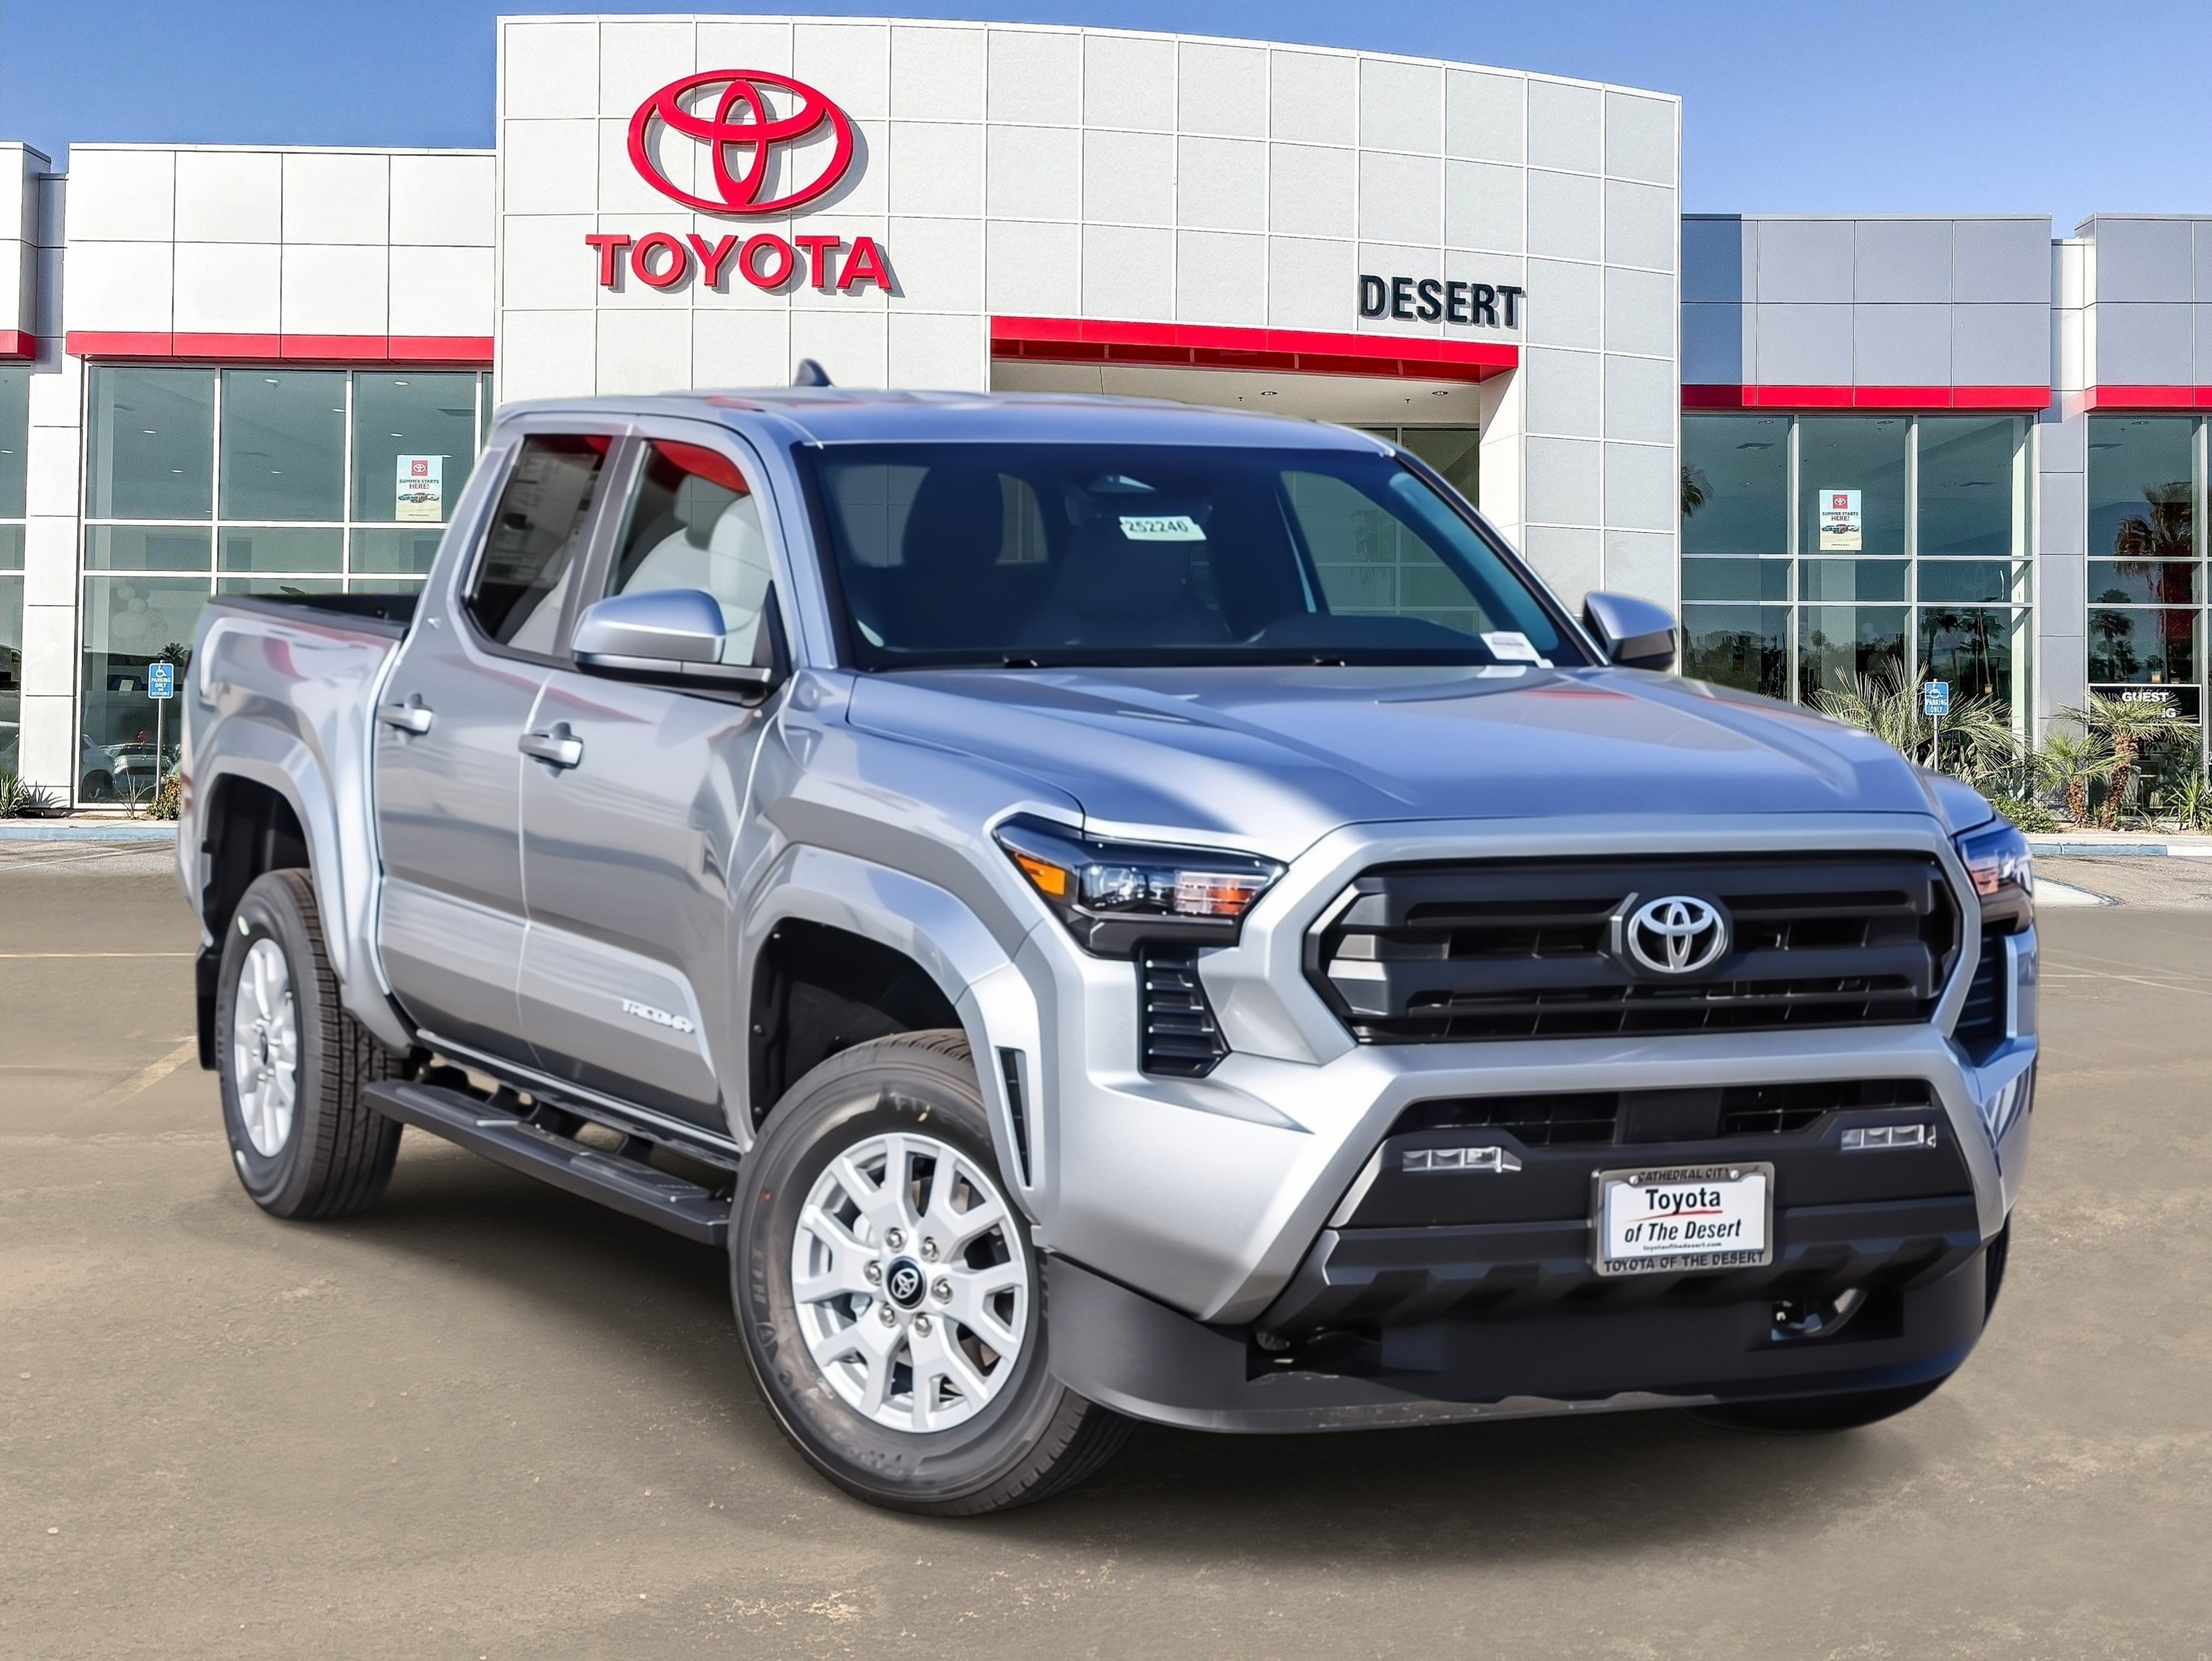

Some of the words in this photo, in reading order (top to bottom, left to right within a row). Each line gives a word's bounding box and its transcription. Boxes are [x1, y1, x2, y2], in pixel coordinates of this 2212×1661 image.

[585, 232, 893, 290] TOYOTA
[1359, 274, 1522, 327] DESERT
[2121, 692, 2169, 703] GUEST
[1638, 1168, 1703, 1181] CATHEDRAL
[1646, 1187, 1721, 1215] Toyota
[1625, 1223, 1643, 1243] of
[1648, 1223, 1678, 1242] The
[1685, 1219, 1742, 1240] Desert
[1604, 1259, 1655, 1272] TOYOTA
[1660, 1257, 1678, 1268] OF
[1681, 1254, 1709, 1266] THE
[1712, 1251, 1764, 1266] DESERT
